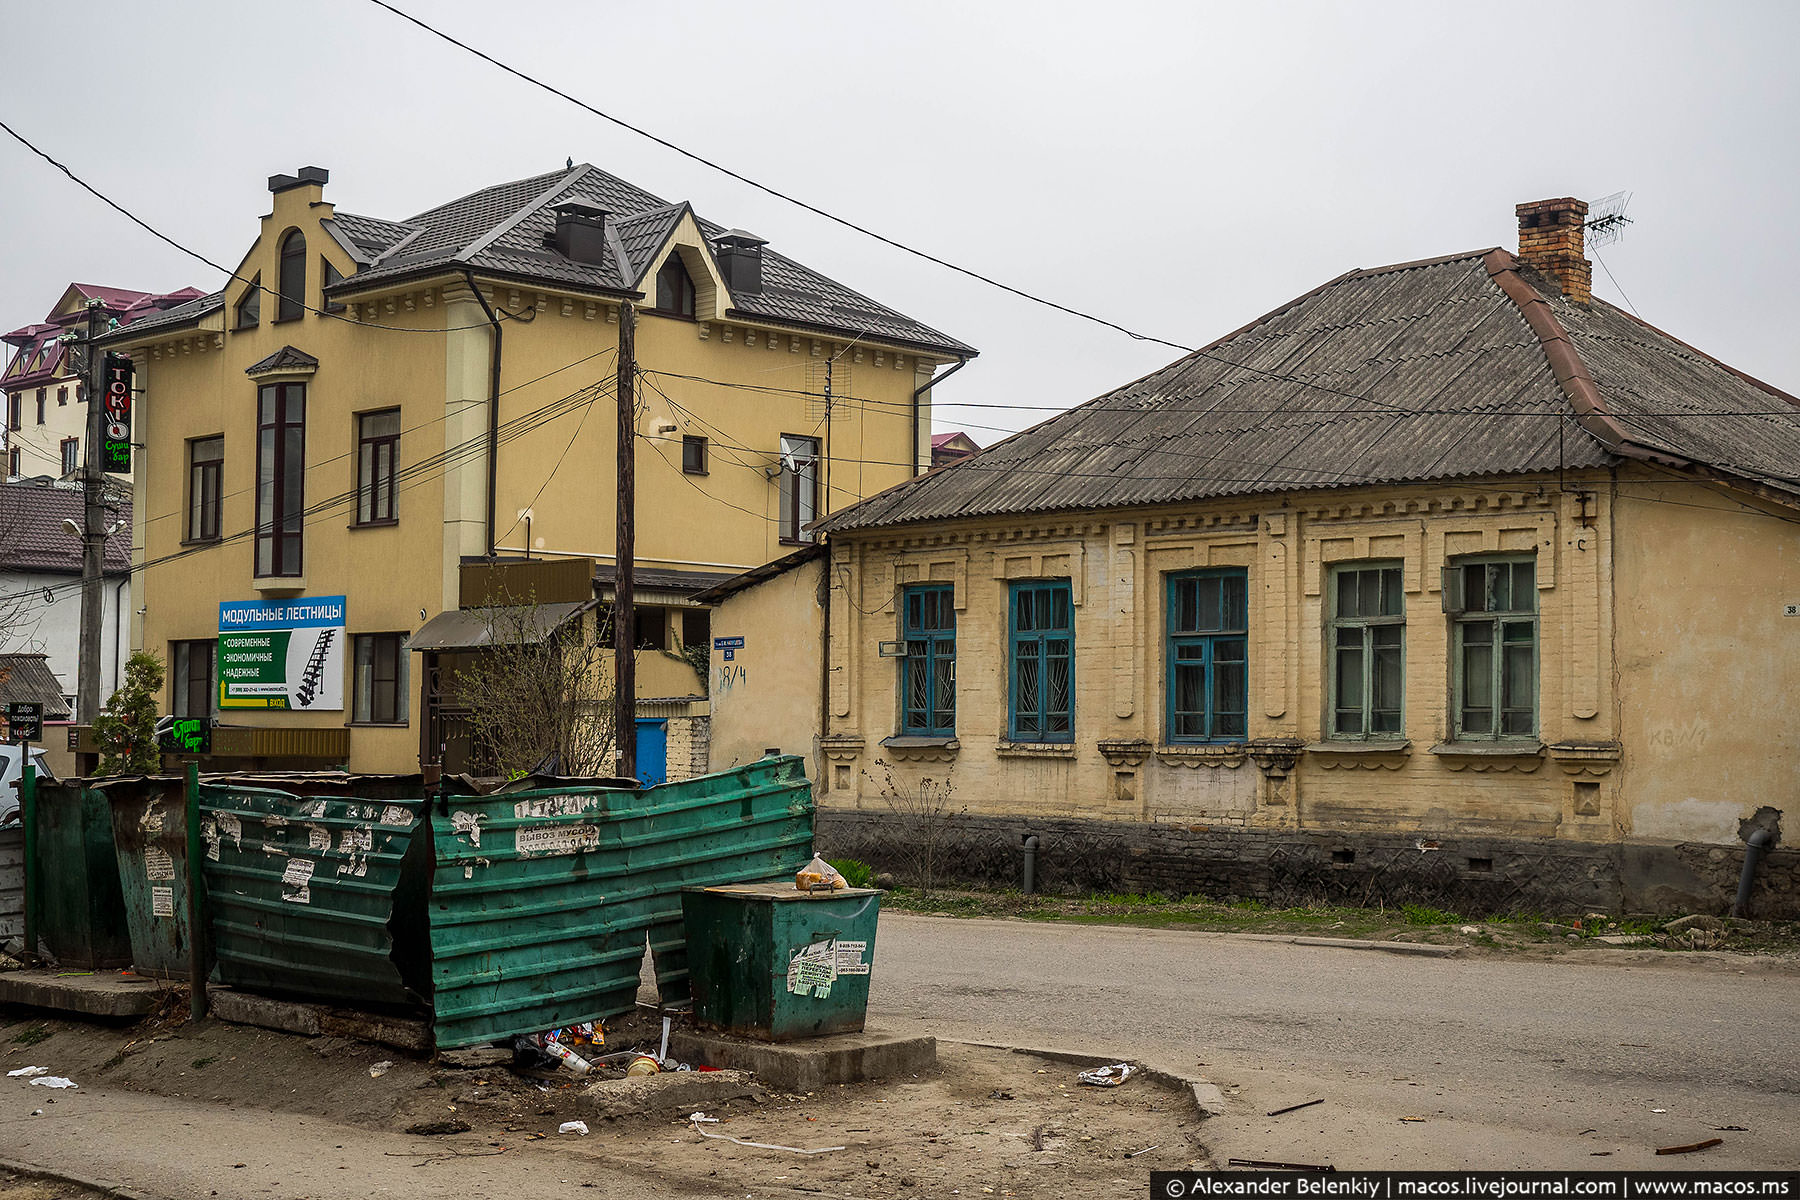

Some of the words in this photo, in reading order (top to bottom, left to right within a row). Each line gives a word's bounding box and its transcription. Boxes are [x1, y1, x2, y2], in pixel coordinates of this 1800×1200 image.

[105, 441, 129, 453] Суши
[113, 453, 129, 464] бар
[222, 608, 283, 624] МОДУЛЬНЫЕ
[286, 605, 342, 620] ЛЕСТНИЦЫ
[1787, 605, 1797, 614] 38
[226, 638, 271, 648] СОВРЕМЕННЫЕ
[226, 653, 273, 662] ЭКОНОМИЧНЫЕ
[226, 668, 260, 679] НАДЕЖНЫЕ
[269, 699, 286, 708] ВХОД
[17, 705, 34, 714] Добро
[184, 733, 203, 753] бар
[520, 832, 556, 843] ВЫВОЗ
